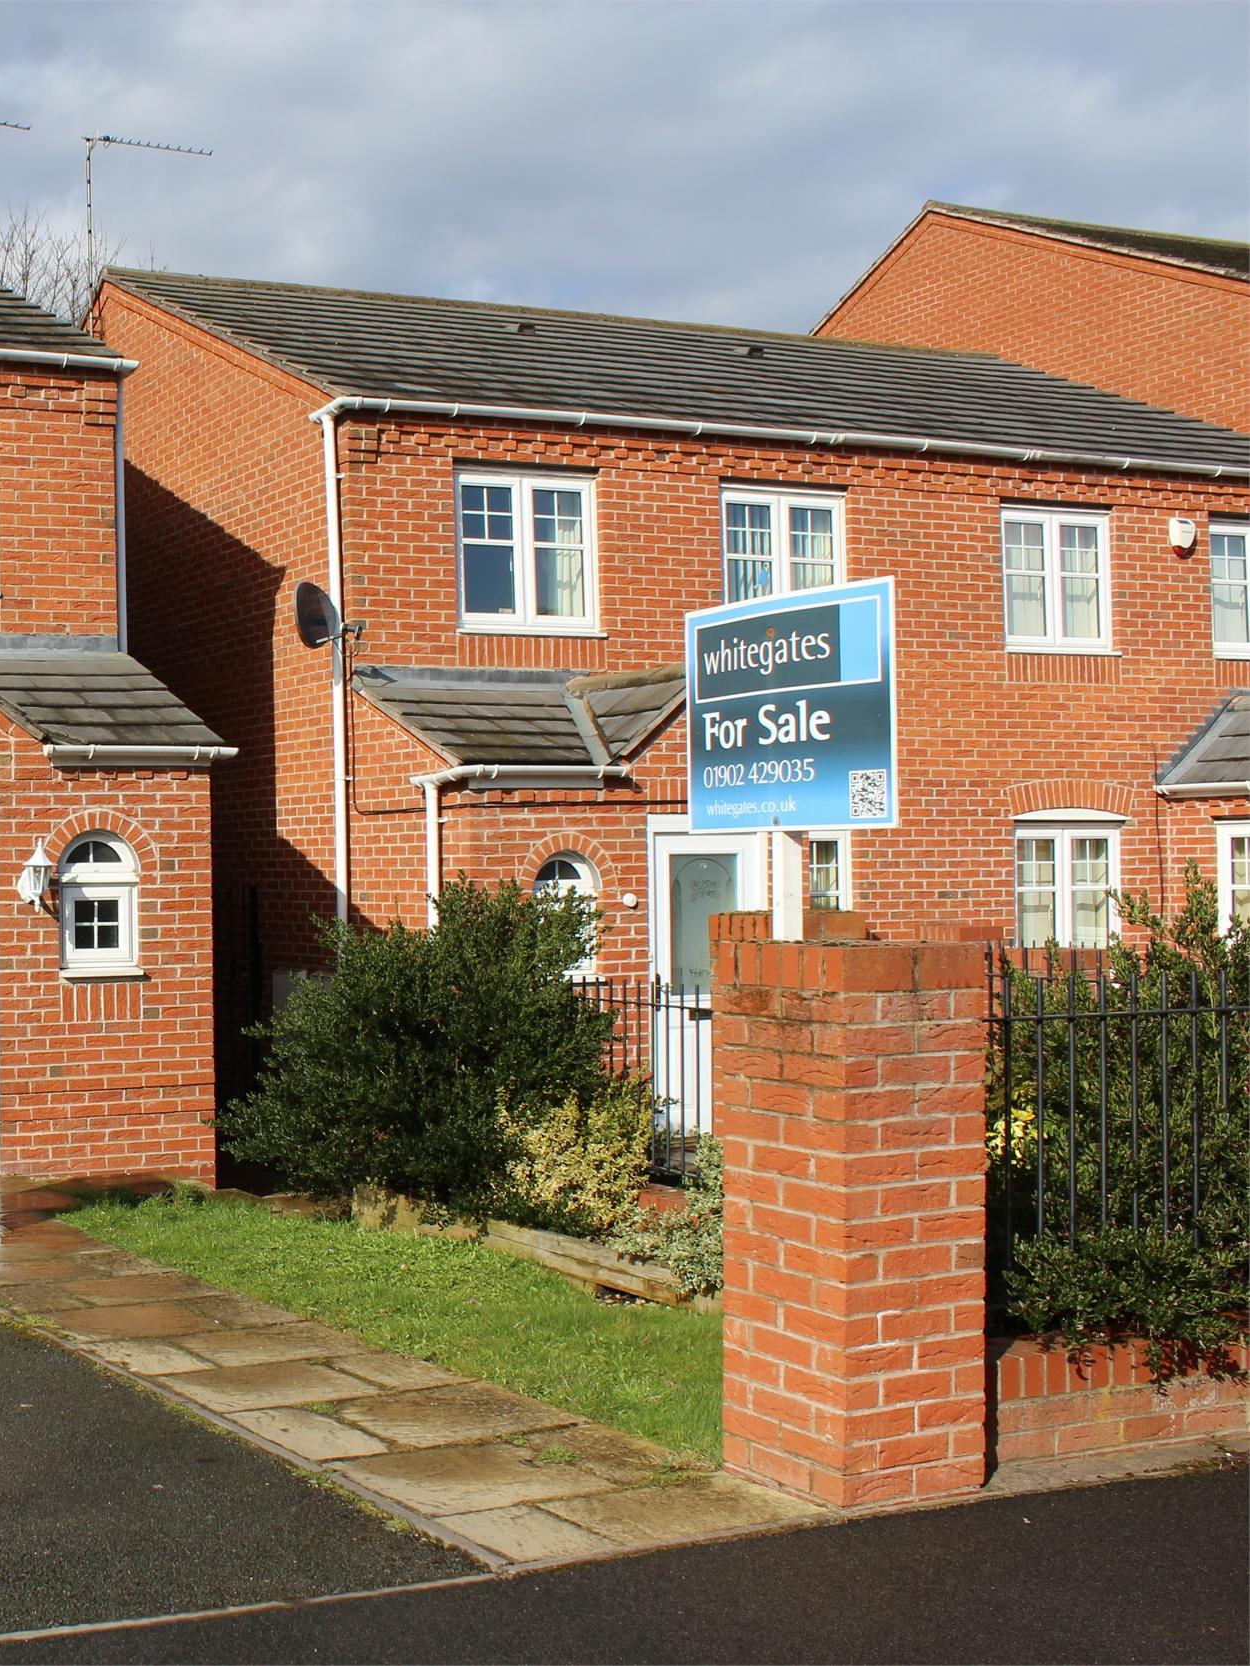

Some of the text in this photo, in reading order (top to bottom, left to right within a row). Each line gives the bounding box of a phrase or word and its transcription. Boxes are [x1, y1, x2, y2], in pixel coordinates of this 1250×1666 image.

[703, 630, 831, 675] whitegates
[702, 699, 831, 751] For Sale
[703, 758, 815, 789] 01902 429035
[706, 794, 797, 819] whitegates.co.uk
